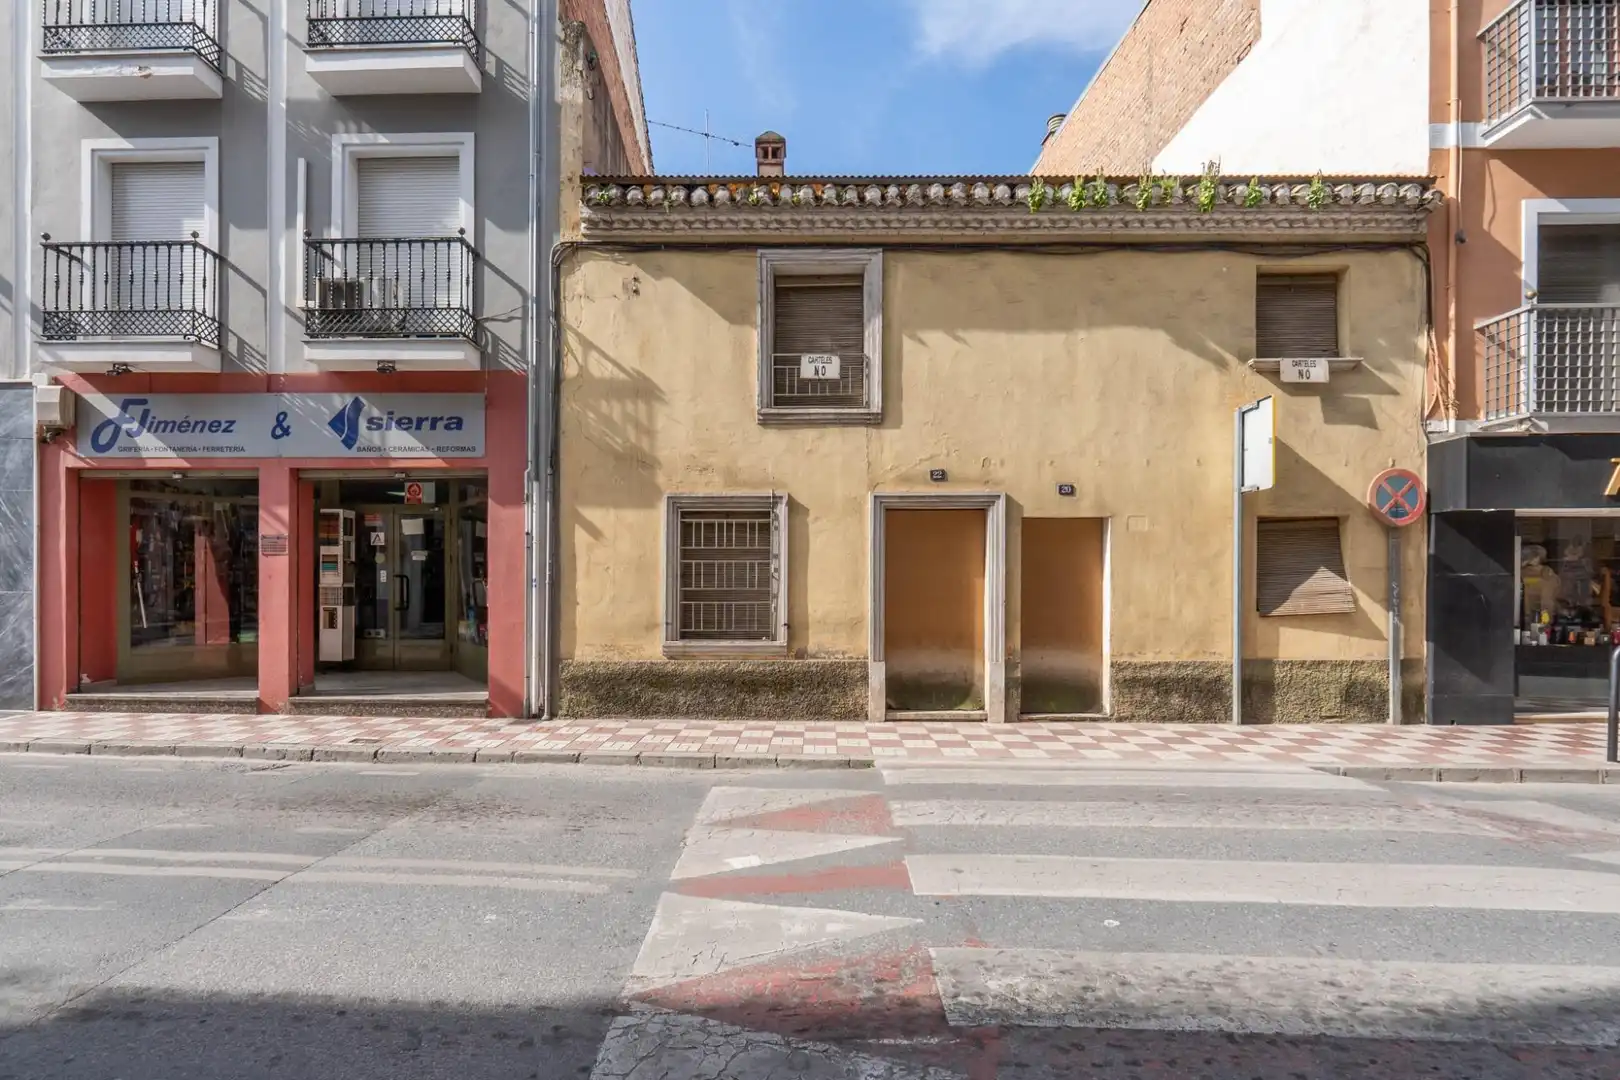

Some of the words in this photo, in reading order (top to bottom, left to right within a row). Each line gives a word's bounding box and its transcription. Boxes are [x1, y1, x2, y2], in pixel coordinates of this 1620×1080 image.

[1291, 360, 1316, 368] CARTELES
[814, 365, 826, 376] NO
[1298, 369, 1311, 380] NO
[271, 411, 292, 440] &
[365, 410, 463, 431] sierra
[436, 445, 476, 453] REFORMAS
